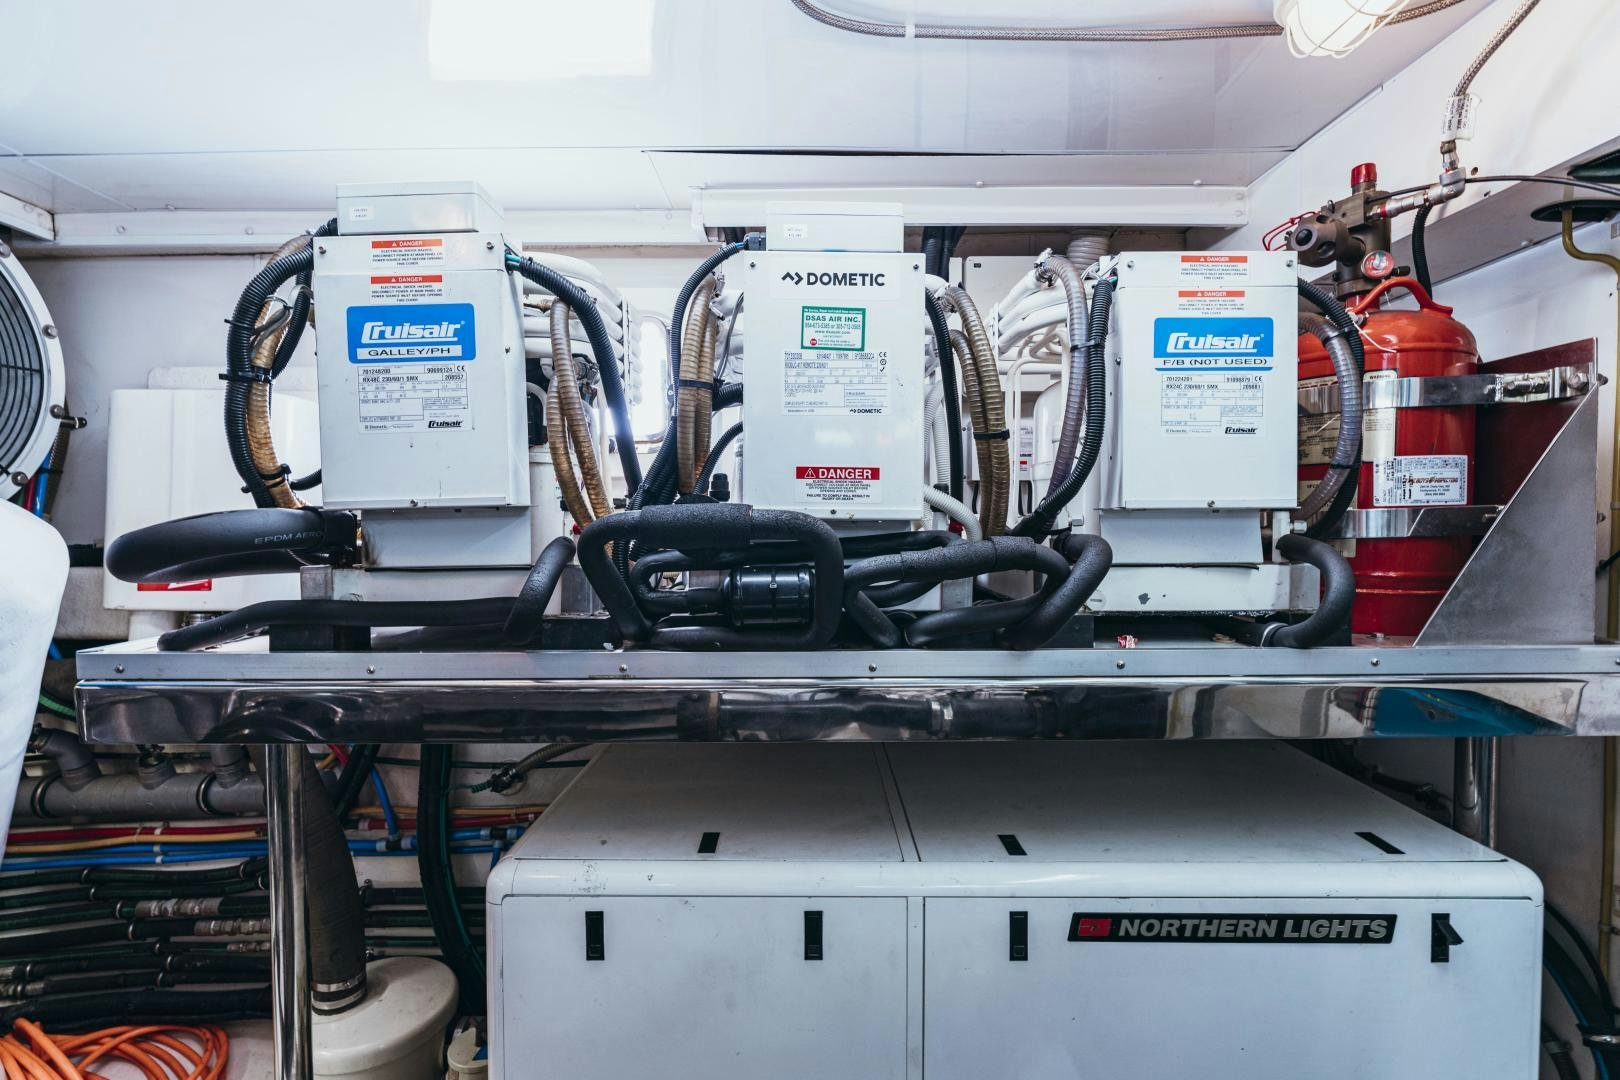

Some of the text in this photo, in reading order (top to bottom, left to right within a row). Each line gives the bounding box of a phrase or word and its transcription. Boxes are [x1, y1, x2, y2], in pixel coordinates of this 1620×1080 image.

[806, 272, 885, 287] DOMETIC
[361, 321, 461, 344] Cruisair
[1166, 332, 1260, 353] Cruisair
[368, 347, 450, 357] GALLEY/PH
[1189, 358, 1220, 366] (NOT
[1224, 358, 1268, 366] USED)
[428, 420, 462, 428] Cruisair
[1225, 426, 1258, 434] Cruisair
[818, 468, 872, 479] DANGER
[255, 533, 293, 545] EPDM
[1118, 918, 1388, 940] NORTHERN LIGHTS
